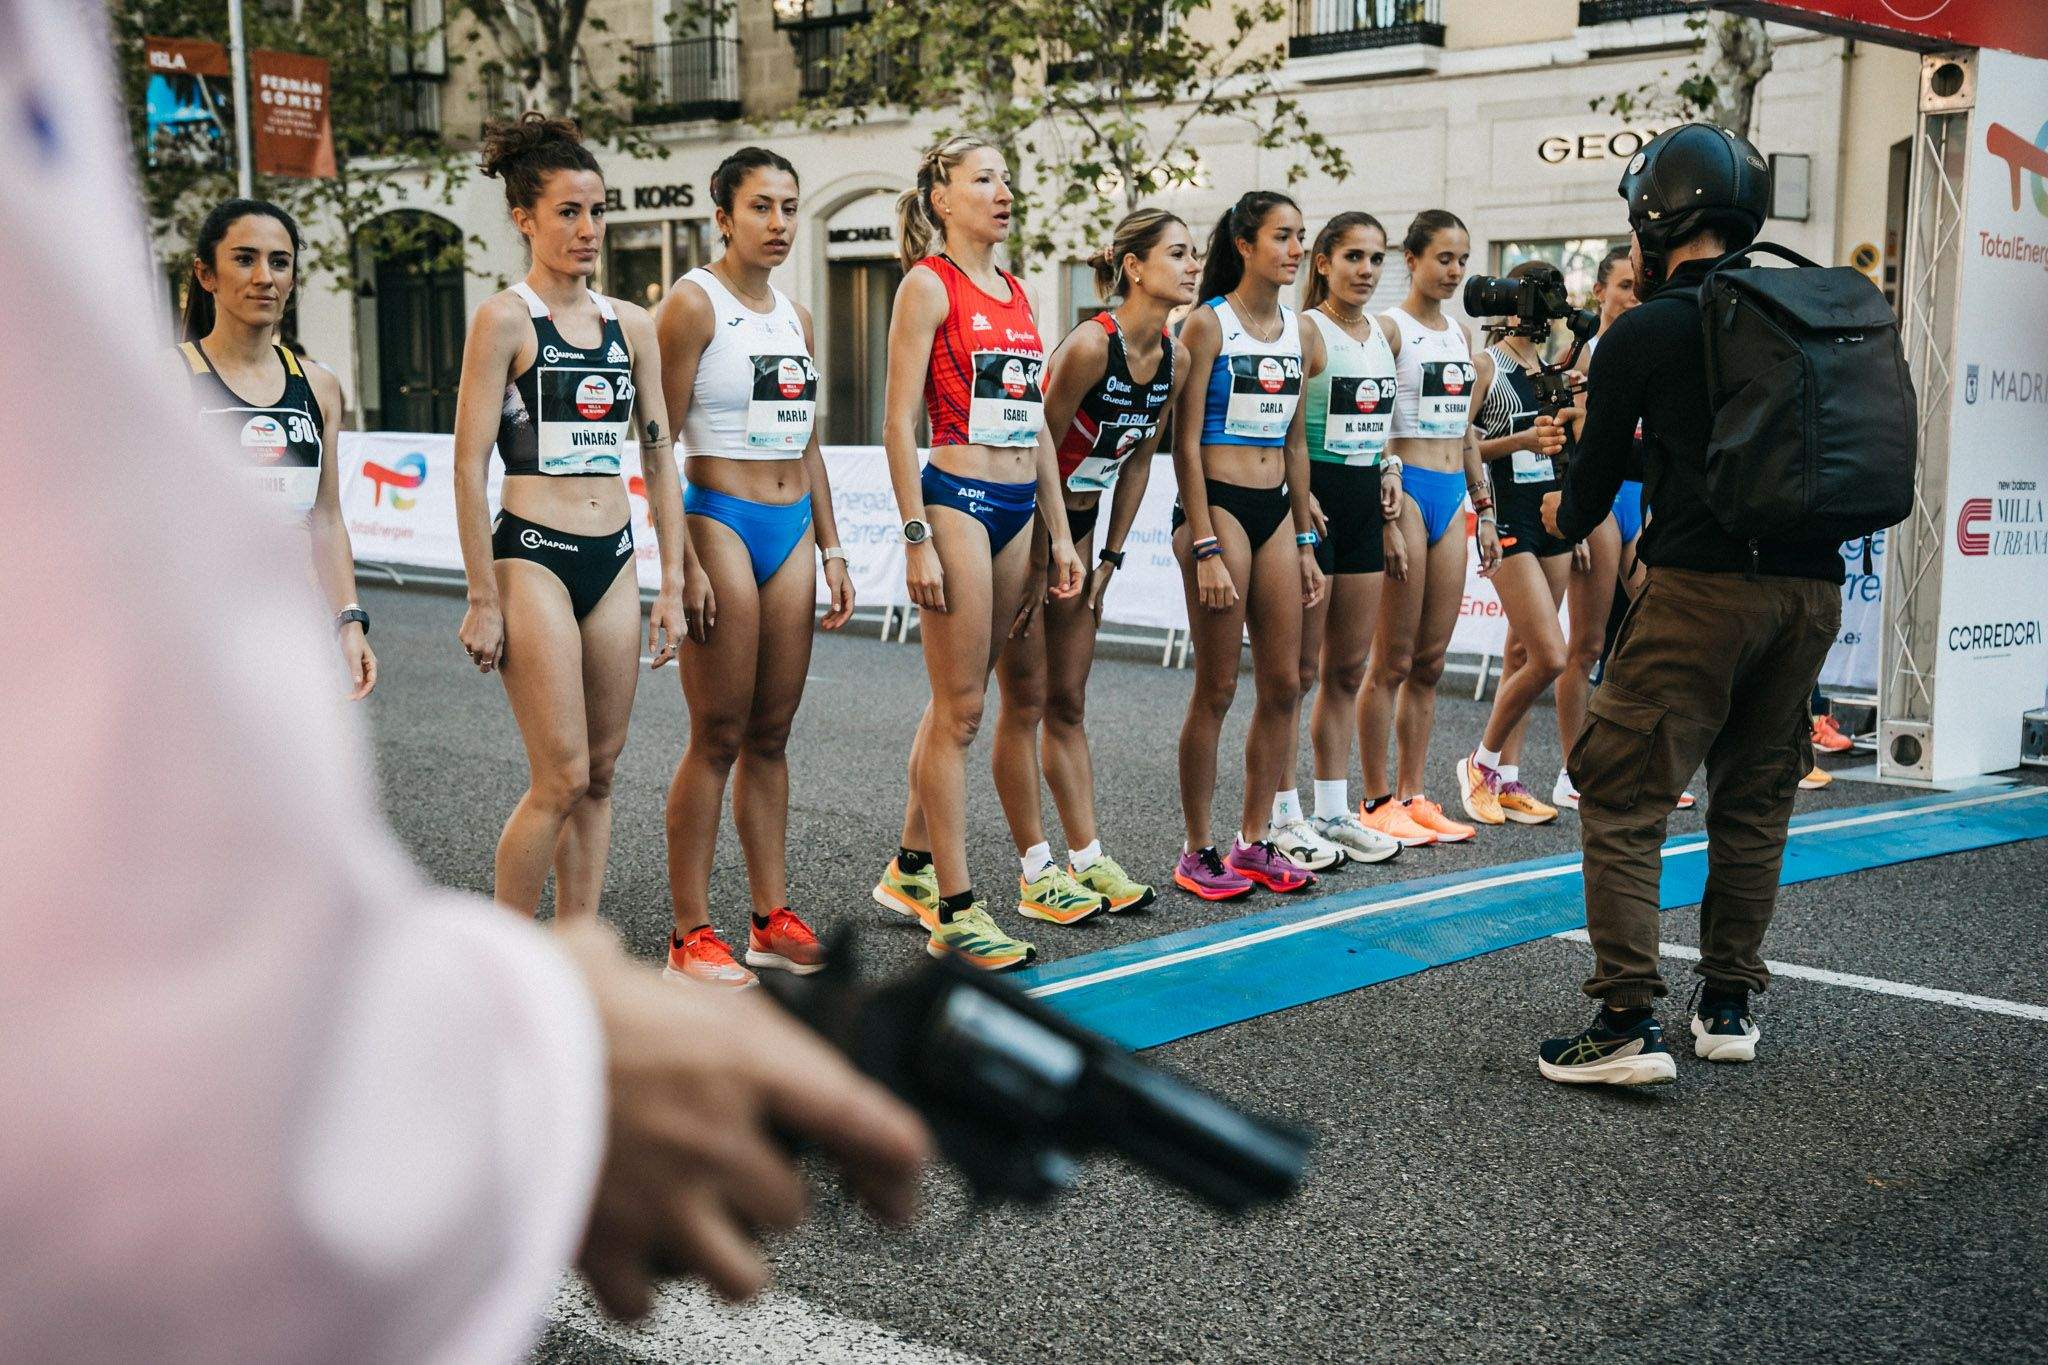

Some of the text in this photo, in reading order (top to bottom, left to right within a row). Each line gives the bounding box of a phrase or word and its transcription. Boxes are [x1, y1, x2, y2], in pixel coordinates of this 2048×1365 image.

[1538, 130, 1658, 164] GEO
[635, 184, 694, 209] KORS
[829, 227, 893, 242] MICHAEL
[1380, 379, 1396, 398] 25
[1003, 408, 1028, 422] ISABEL
[1260, 402, 1284, 414] CARLA
[288, 416, 314, 443] 30
[957, 487, 985, 499] ADM
[1997, 499, 2044, 523] MILLA
[538, 538, 579, 552] MAPOMA
